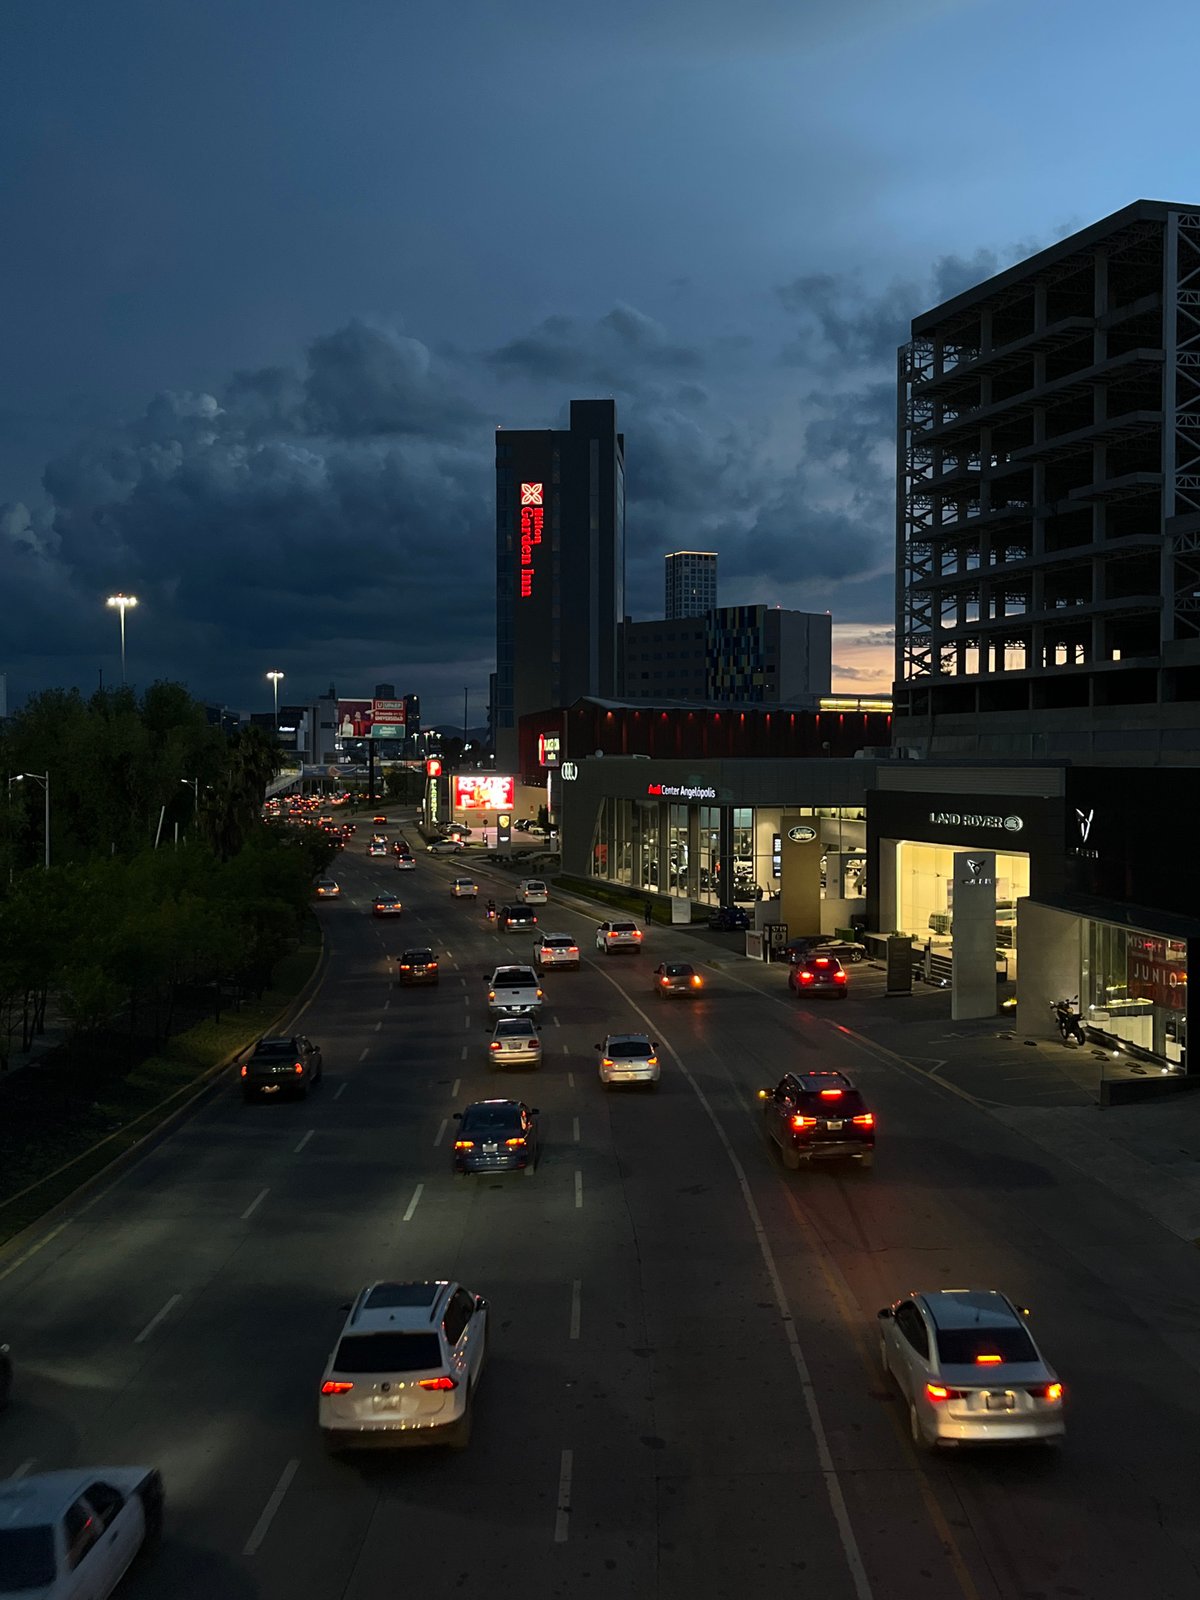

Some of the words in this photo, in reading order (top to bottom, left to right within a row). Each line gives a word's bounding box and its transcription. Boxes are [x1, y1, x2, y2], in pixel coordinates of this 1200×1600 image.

[521, 506, 535, 565] Garden
[533, 507, 544, 544] Hilton
[521, 568, 535, 597] Inn
[430, 761, 440, 775] P
[661, 784, 680, 796] Center
[680, 785, 716, 800] Angelópolis
[930, 812, 961, 826] LAND
[962, 814, 1004, 829] ROVER
[1134, 962, 1178, 988] JUNIO
